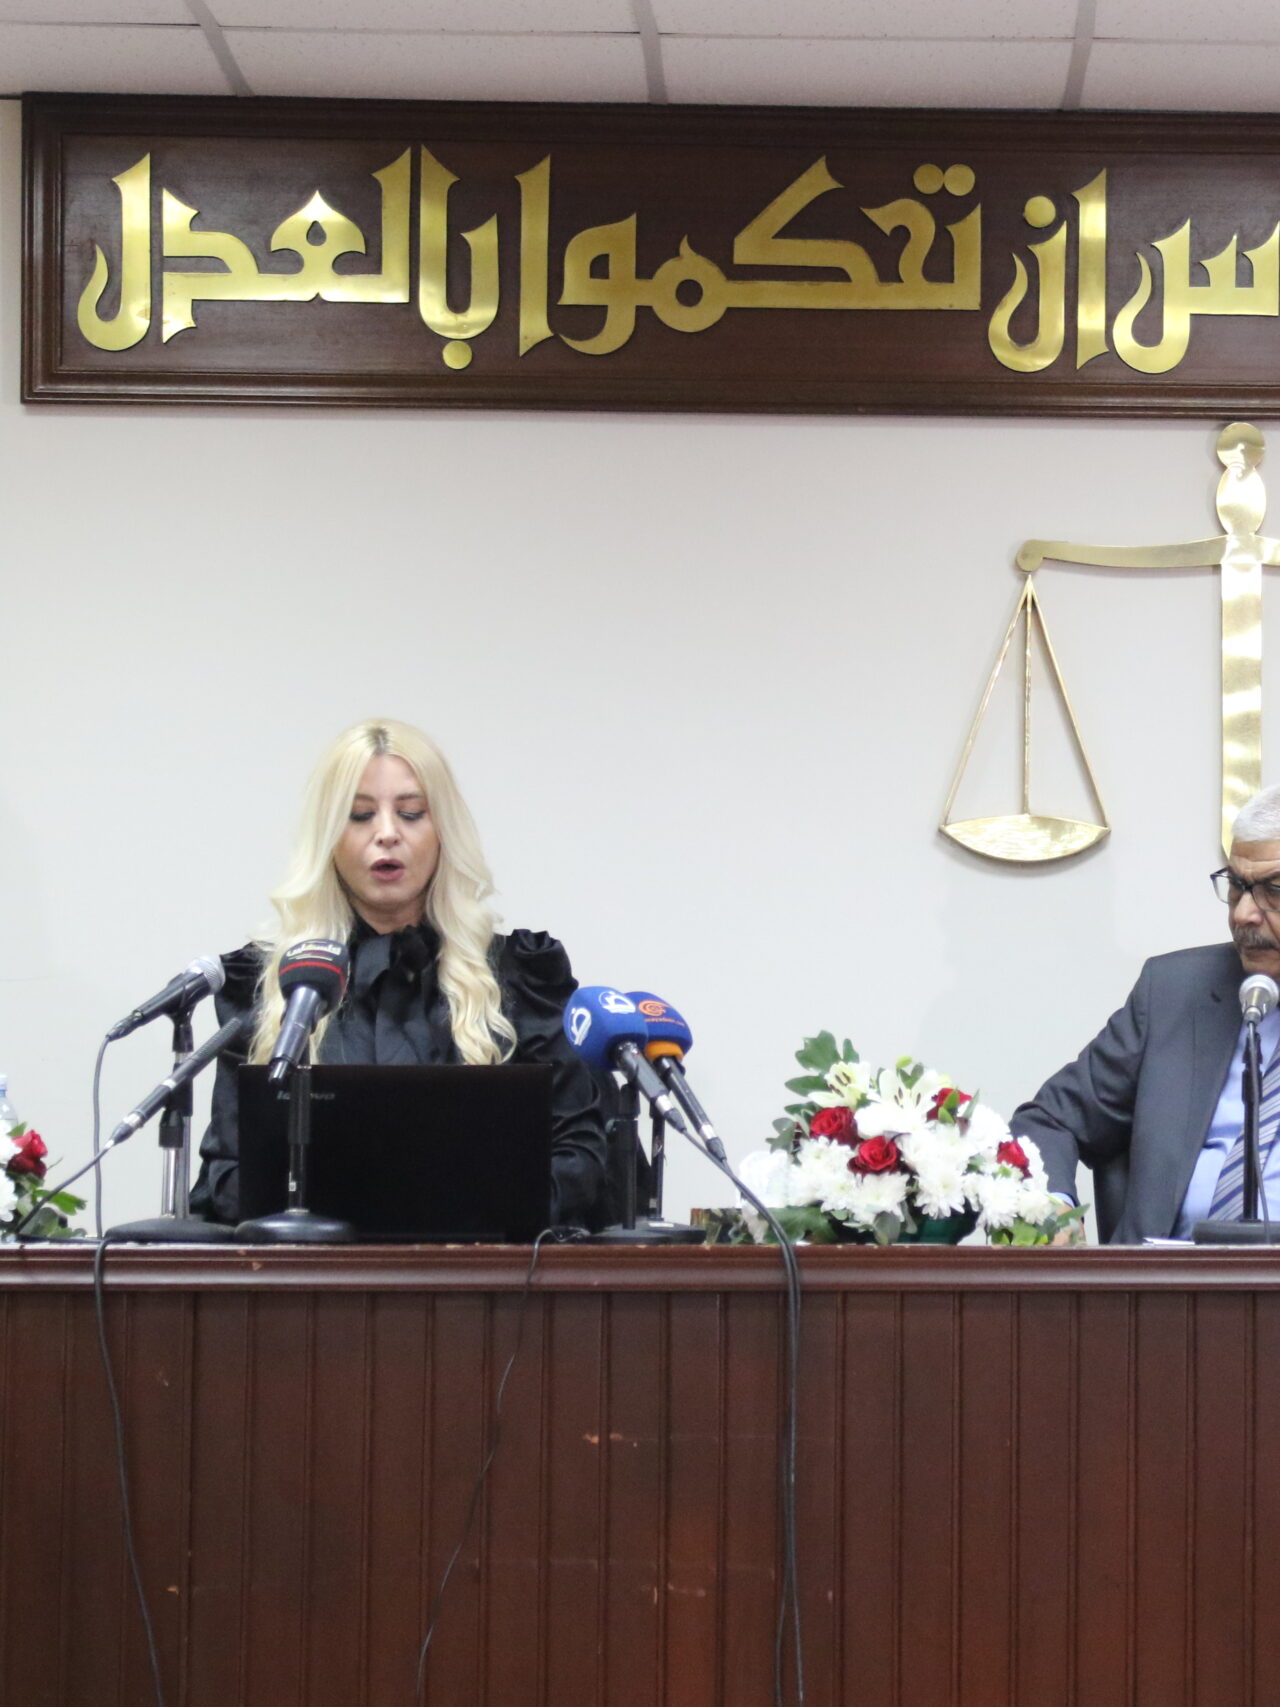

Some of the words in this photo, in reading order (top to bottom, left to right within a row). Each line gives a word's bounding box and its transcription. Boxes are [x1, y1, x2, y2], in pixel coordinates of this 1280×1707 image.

[76, 145, 501, 370] بالعدل
[516, 153, 982, 358] تحكموا
[987, 166, 1110, 373] ان
[277, 1090, 336, 1101] levo
